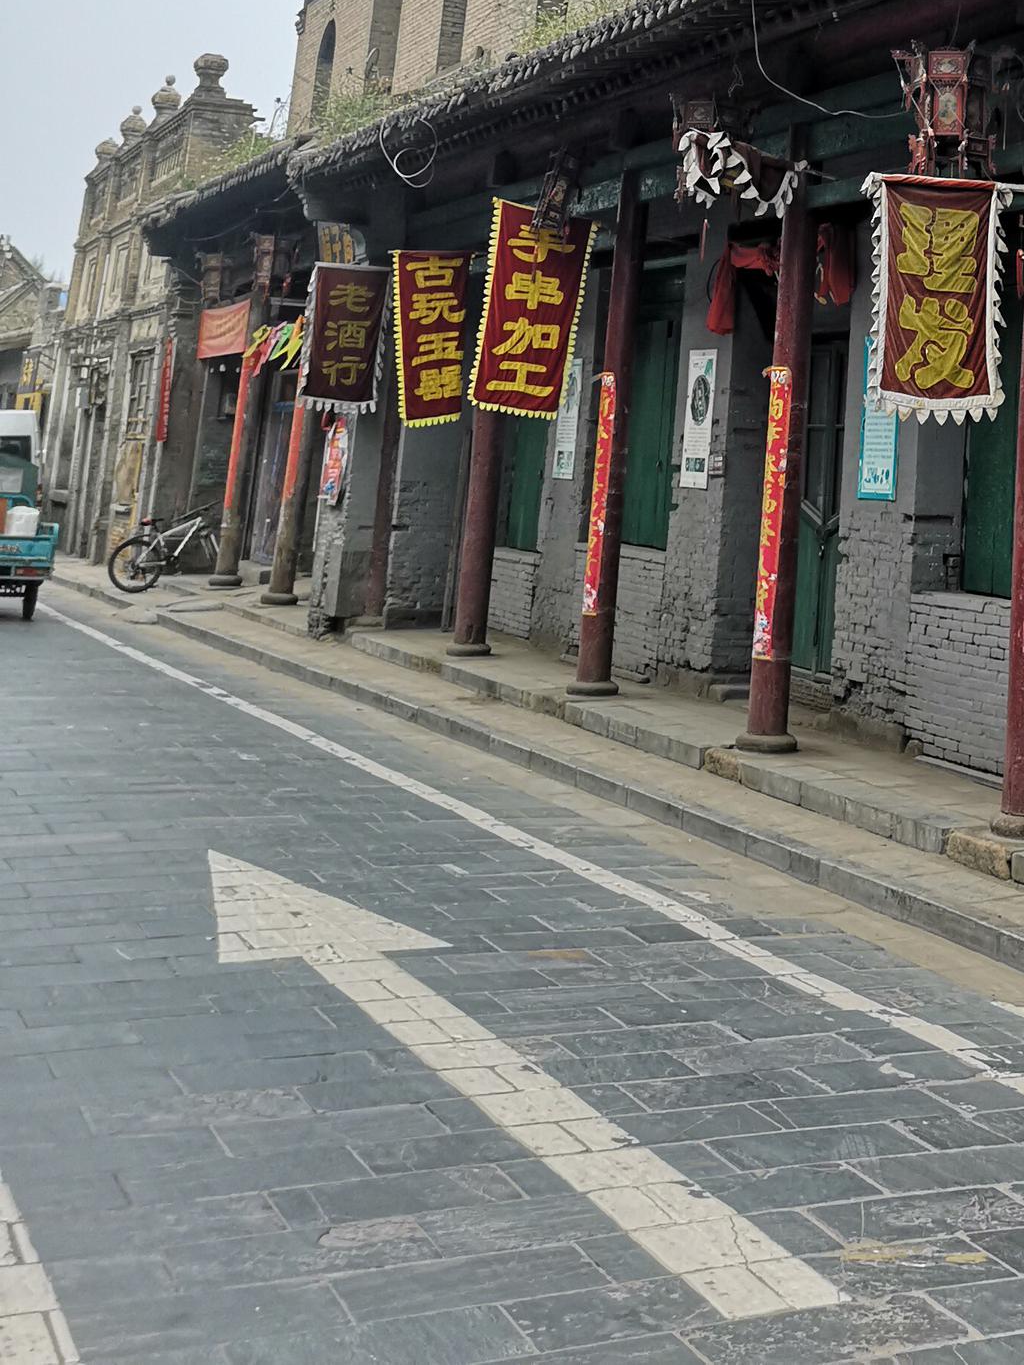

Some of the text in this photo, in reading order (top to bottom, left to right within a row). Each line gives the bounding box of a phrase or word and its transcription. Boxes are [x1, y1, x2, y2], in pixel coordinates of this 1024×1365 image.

[320, 281, 376, 387] 老酒行
[405, 255, 467, 402] 古玩玉器
[485, 223, 577, 397] 手串加工
[895, 201, 976, 390] 理发
